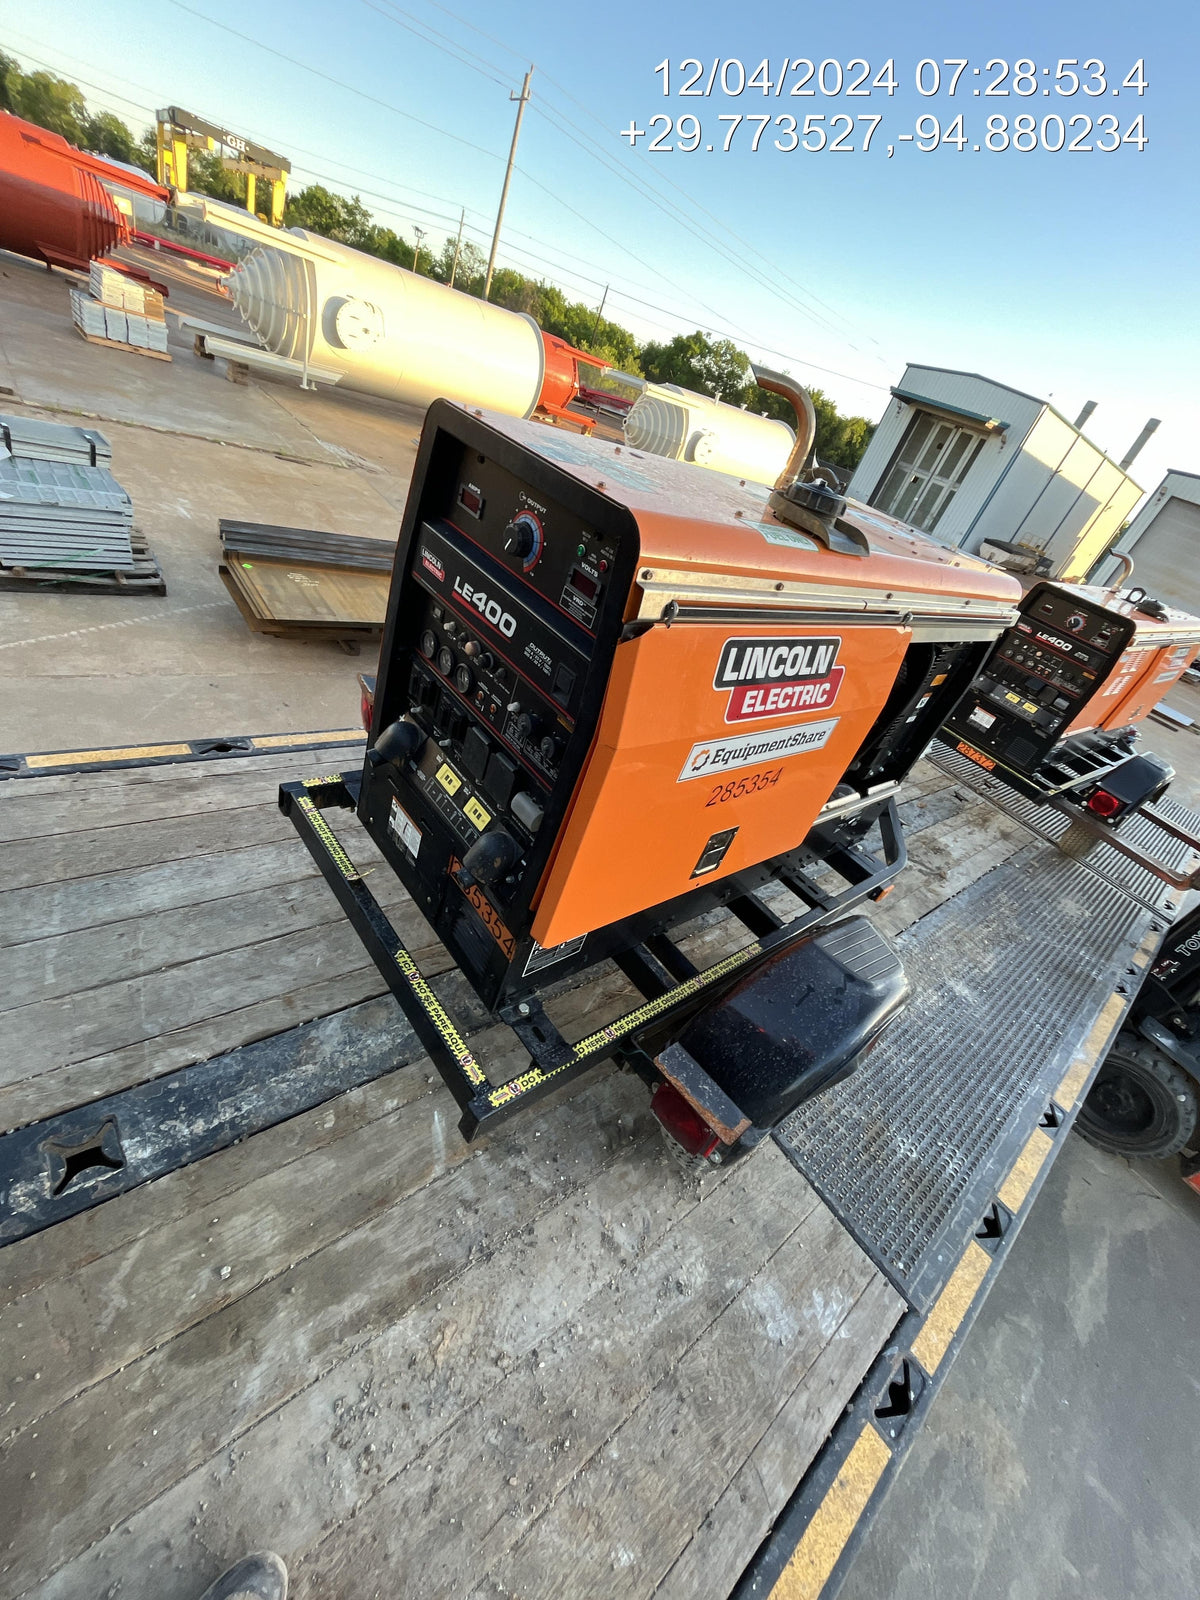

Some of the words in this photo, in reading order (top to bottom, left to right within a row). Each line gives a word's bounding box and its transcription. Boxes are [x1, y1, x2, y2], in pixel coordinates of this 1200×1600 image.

[526, 498, 547, 513] OUTPUT
[581, 561, 599, 578] VOLTS
[453, 575, 517, 638] LE400
[1037, 631, 1073, 652] LE400
[722, 644, 834, 682] LINCOLN
[741, 682, 831, 714] ELECTRIC
[710, 730, 826, 767] EquipmentShare
[957, 742, 995, 771] 287372
[704, 766, 784, 808] 285354
[316, 822, 327, 836] NOT
[324, 834, 340, 856] STAND
[337, 855, 351, 873] HERE
[402, 959, 411, 971] ICI
[415, 980, 426, 994] NO
[423, 993, 434, 1007] SE
[431, 1006, 449, 1031] PARE
[585, 1034, 605, 1049] HERE
[614, 1023, 625, 1032] NE
[624, 1014, 640, 1026] PAS
[639, 1001, 661, 1018] TENEZ
[661, 987, 687, 1005] DEBOUT
[521, 1075, 536, 1087] DO
